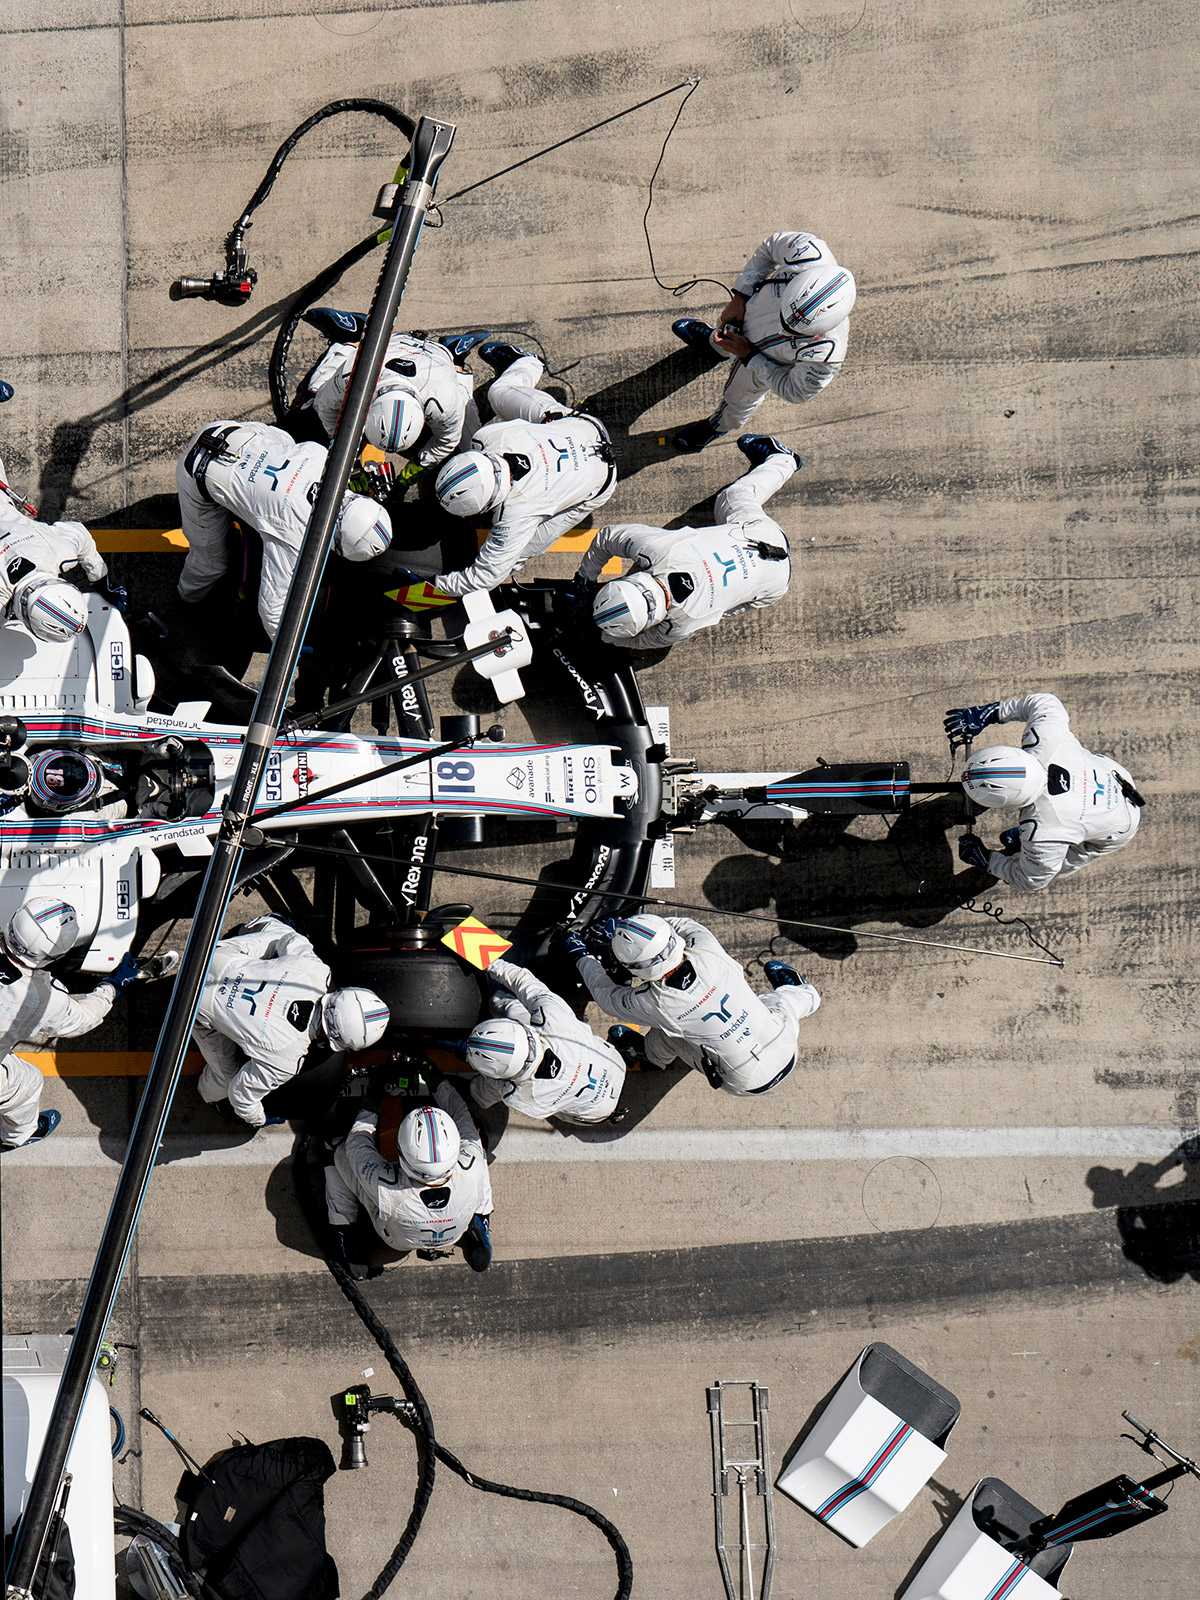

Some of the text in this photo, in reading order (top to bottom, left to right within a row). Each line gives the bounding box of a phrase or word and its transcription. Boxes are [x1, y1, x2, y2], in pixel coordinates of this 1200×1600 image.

[246, 449, 269, 484] randstad
[536, 443, 547, 464] MARTINI
[565, 436, 579, 471] randstad
[285, 471, 299, 494] MARTINI
[9, 533, 34, 546] WILLIAMS
[702, 559, 714, 583] MARTINI
[730, 543, 750, 580] randstad
[111, 642, 124, 680] JCB
[392, 655, 420, 711] Rexna
[146, 716, 188, 729] randstad
[657, 722, 669, 737] 30
[45, 768, 65, 787] 18
[242, 780, 255, 802] FRONT
[266, 753, 282, 801] JCB
[437, 761, 475, 793] 18
[526, 759, 535, 798] avanade
[563, 756, 574, 803] PIRELLI
[583, 756, 598, 804] ORIS
[163, 826, 205, 841] randstad
[662, 857, 674, 872] 30
[117, 880, 130, 919] JCB
[224, 972, 245, 1010] randstad
[273, 970, 288, 994] WILLIAMS
[264, 993, 276, 1018] MARTINI
[676, 985, 717, 1021] WILLIAMS MARTINI
[718, 1008, 749, 1040] randstad
[552, 1062, 583, 1106] WILLIAMS MARTINI
[590, 1068, 609, 1104] randstad
